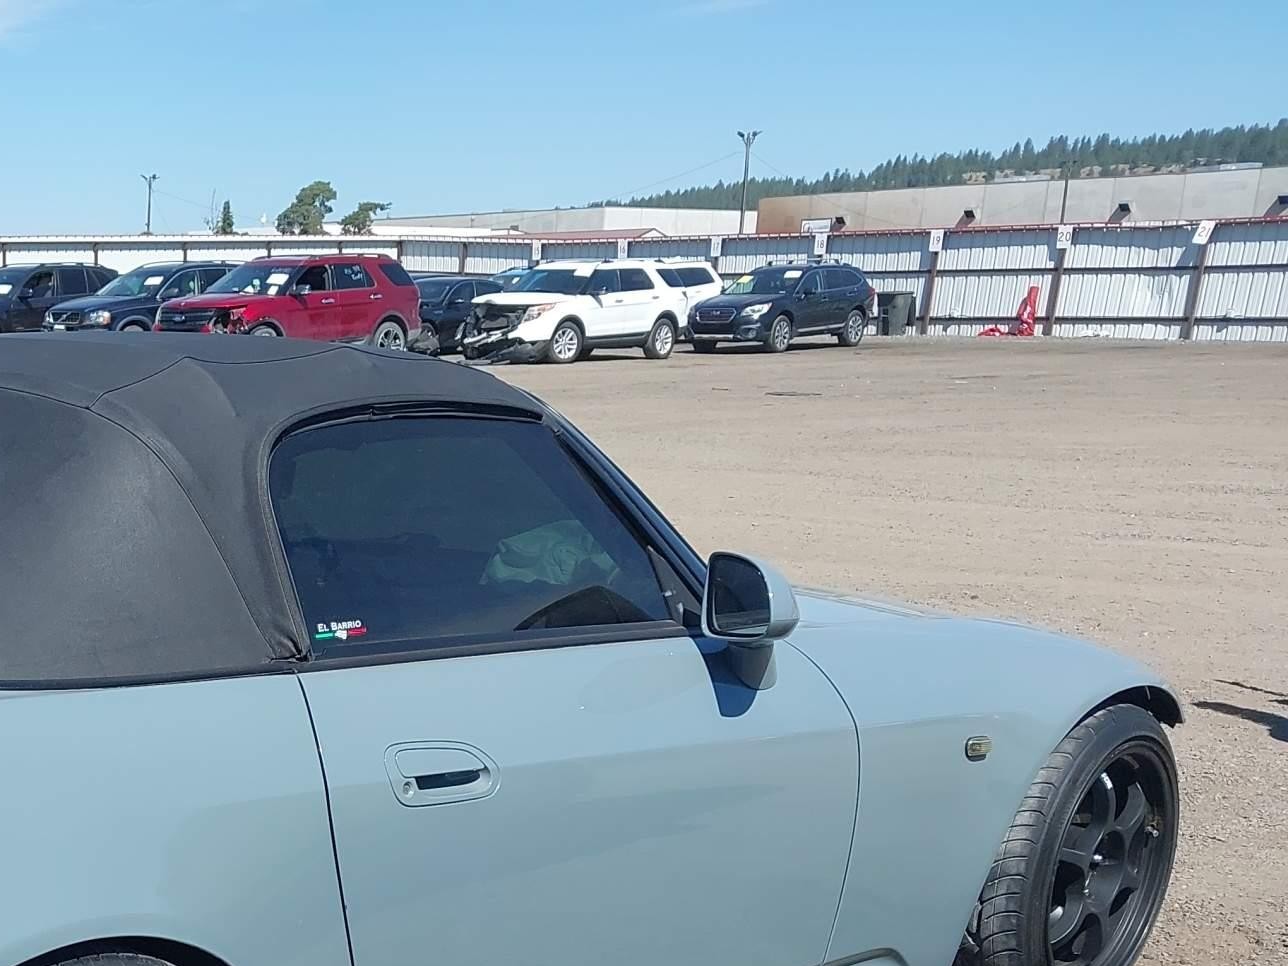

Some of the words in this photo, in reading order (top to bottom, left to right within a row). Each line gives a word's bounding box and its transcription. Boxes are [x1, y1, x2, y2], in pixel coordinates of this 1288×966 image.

[1057, 231, 1072, 242] 20
[1198, 226, 1211, 238] 21
[816, 239, 825, 249] 18
[931, 235, 941, 245] 19
[317, 623, 329, 632] EL
[331, 620, 362, 631] BARRIO
